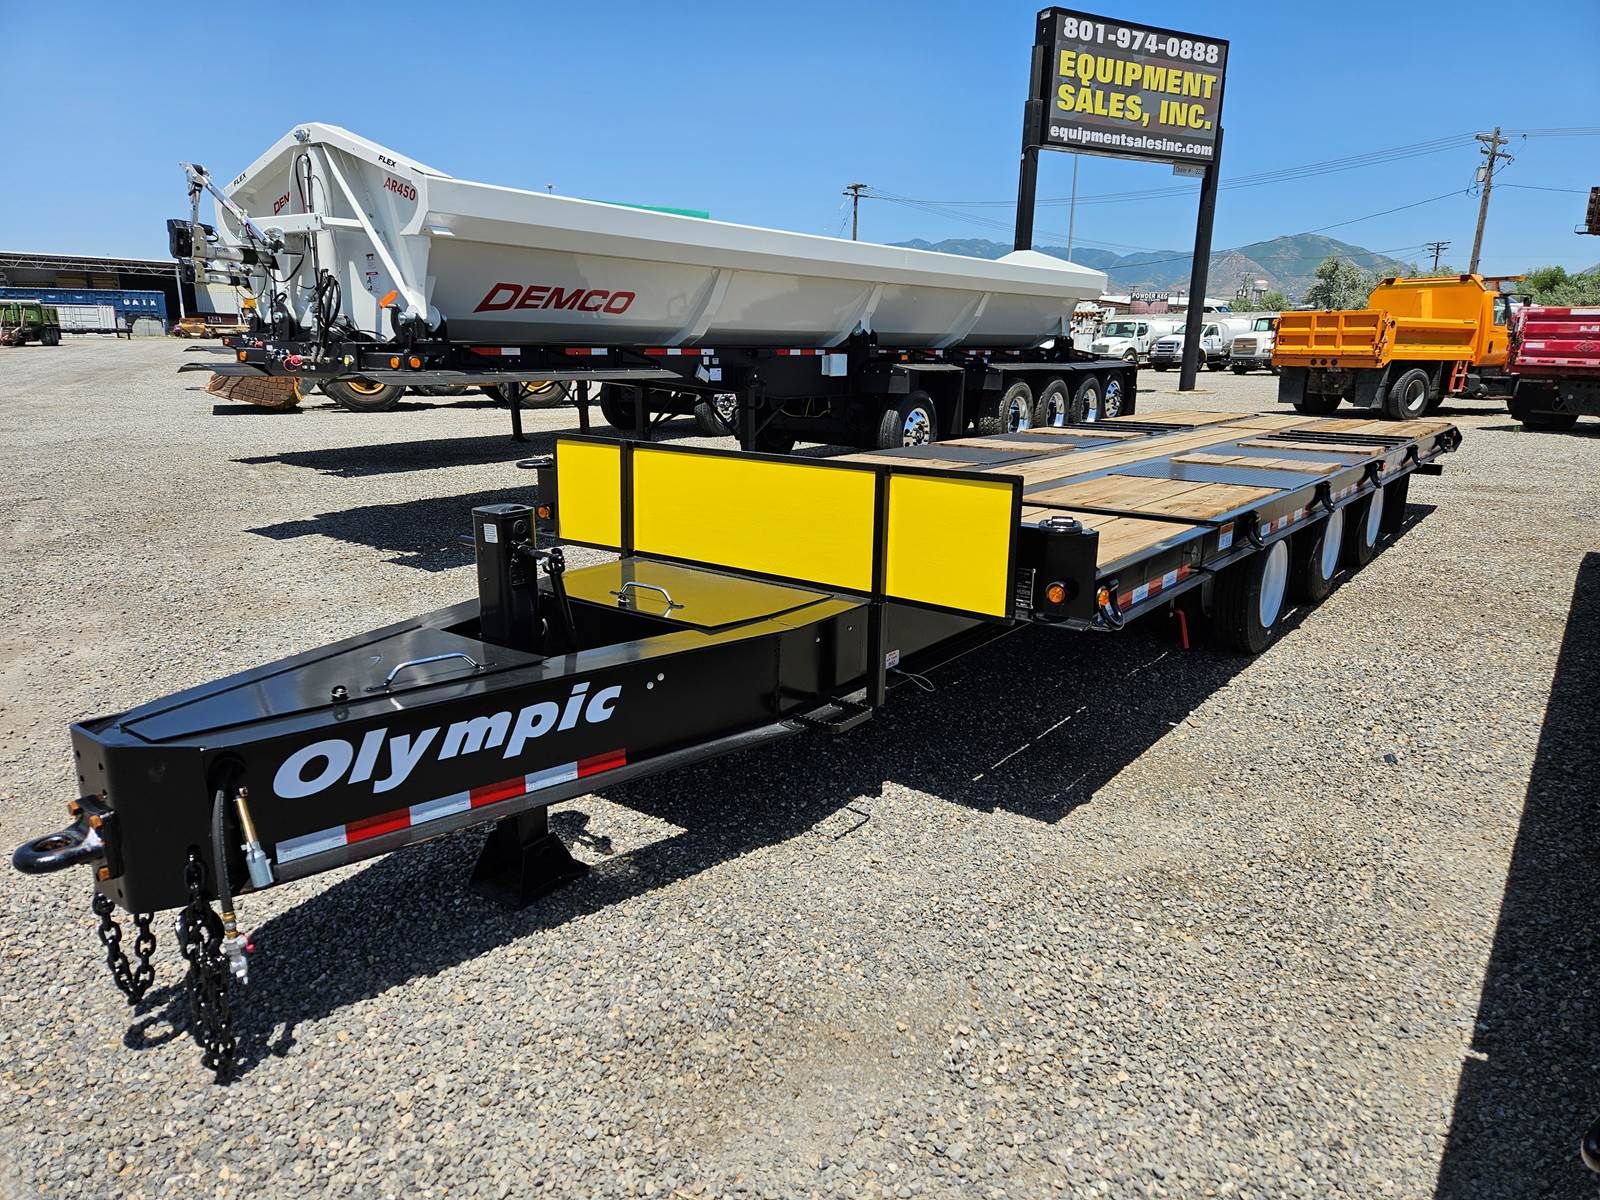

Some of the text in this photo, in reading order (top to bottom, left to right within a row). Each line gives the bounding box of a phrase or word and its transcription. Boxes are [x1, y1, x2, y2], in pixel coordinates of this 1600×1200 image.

[1063, 17, 1219, 64] 801-974-0888
[1058, 49, 1217, 99] EQUIPMENT
[1056, 83, 1212, 130] SALES, INC.
[1050, 125, 1213, 156] equipmentsalesinc.com
[378, 154, 397, 168] FLEX
[233, 172, 248, 187] FLEX
[383, 177, 416, 201] AR450
[472, 282, 636, 315] DEMCO
[272, 681, 622, 799] Olympic
